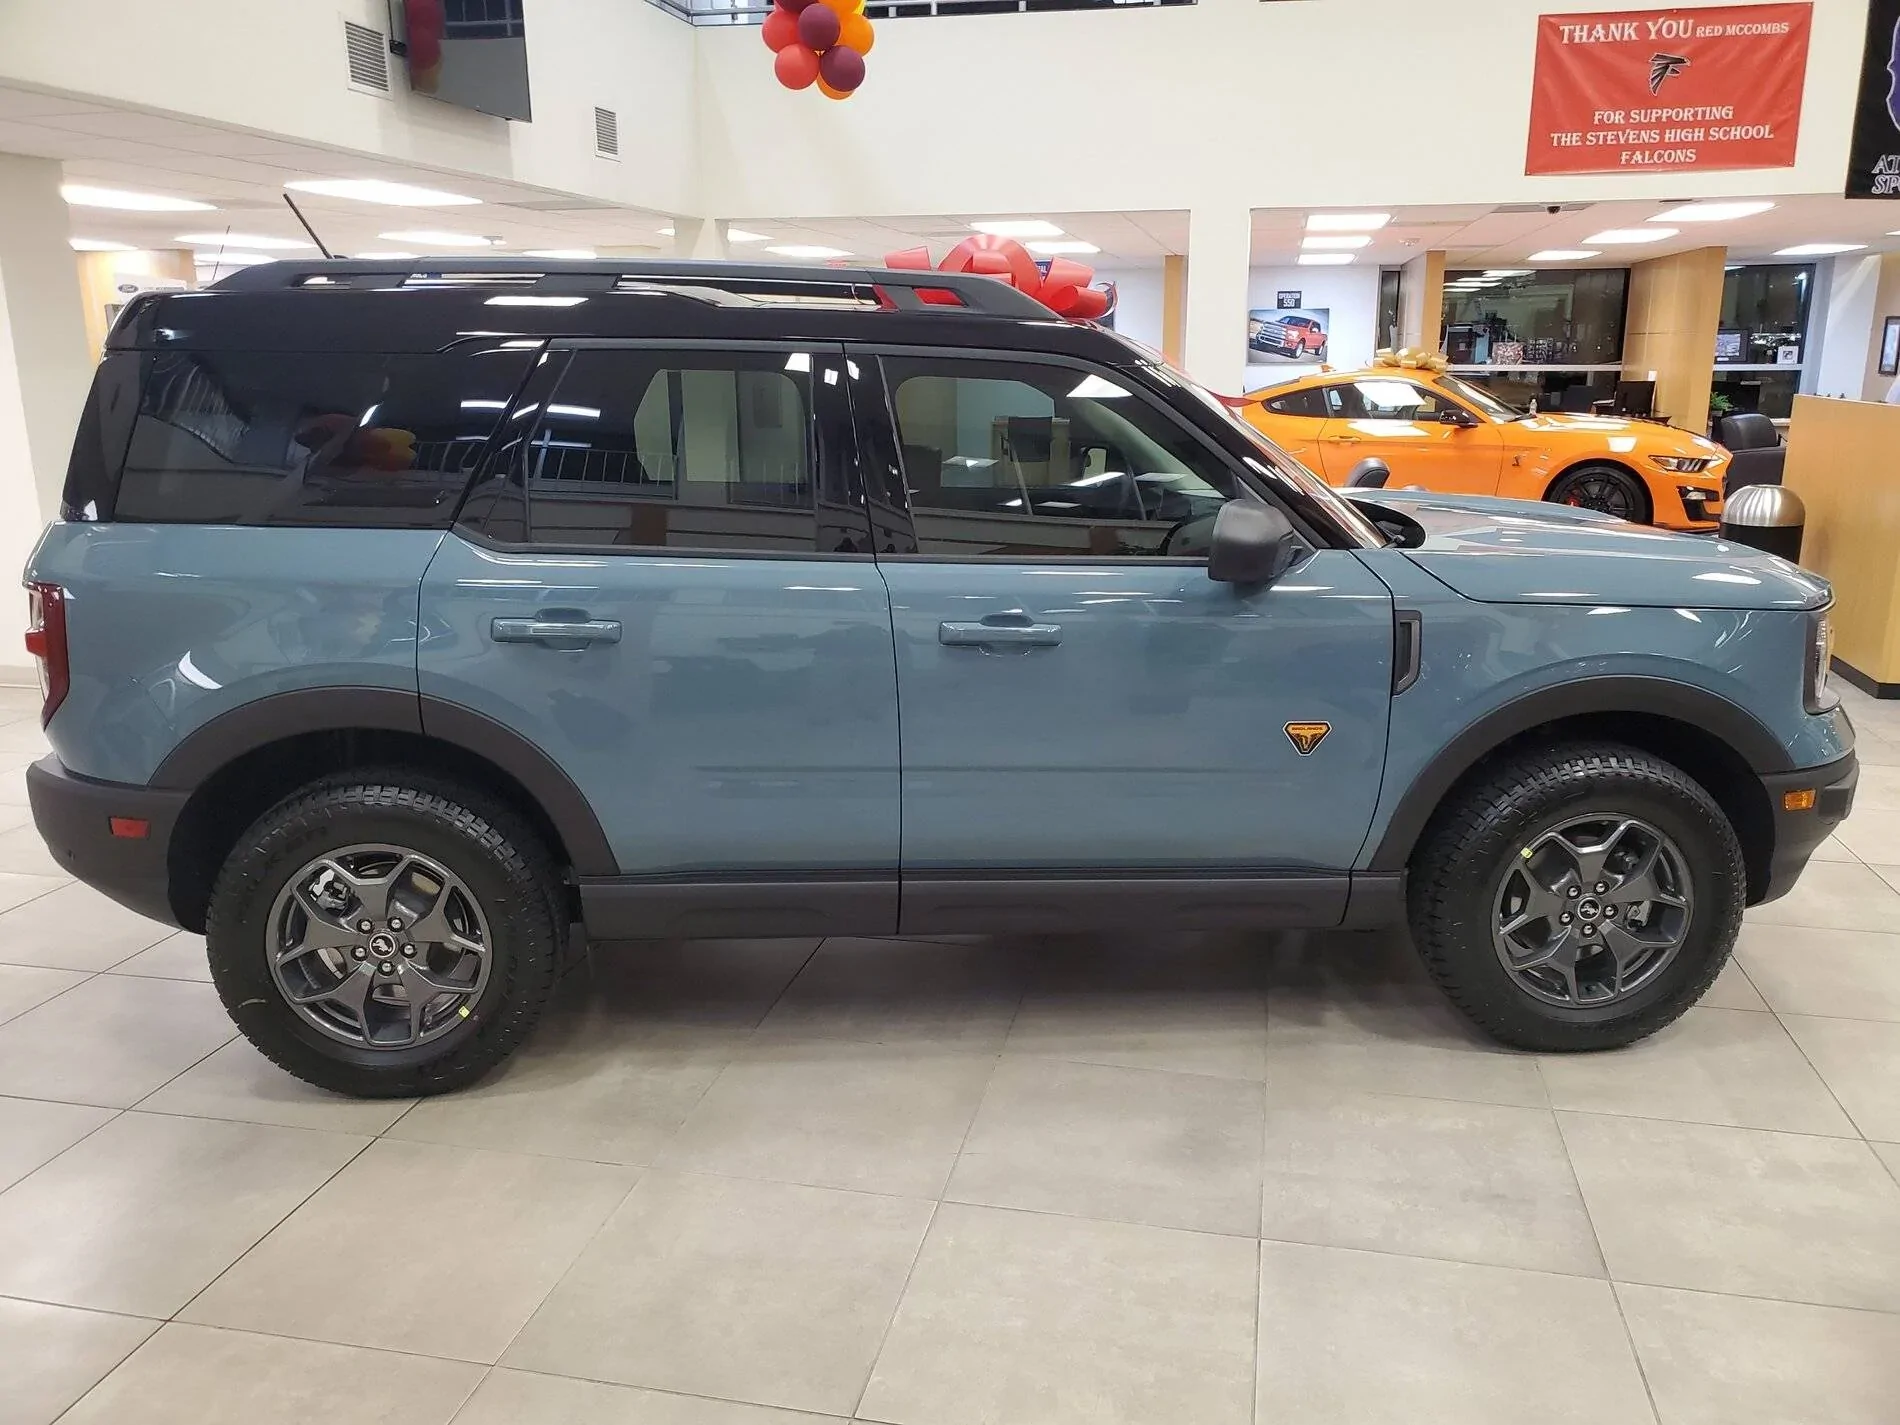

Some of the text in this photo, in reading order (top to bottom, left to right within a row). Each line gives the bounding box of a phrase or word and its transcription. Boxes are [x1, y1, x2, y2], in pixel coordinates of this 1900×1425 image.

[1559, 16, 1790, 44] THANK YOU RED MCCOMBS
[1593, 106, 1734, 125] FOR SUPPORTING
[1550, 124, 1775, 147] THE STEVENS HIGH SCHOOL
[1620, 148, 1697, 165] FALCONS
